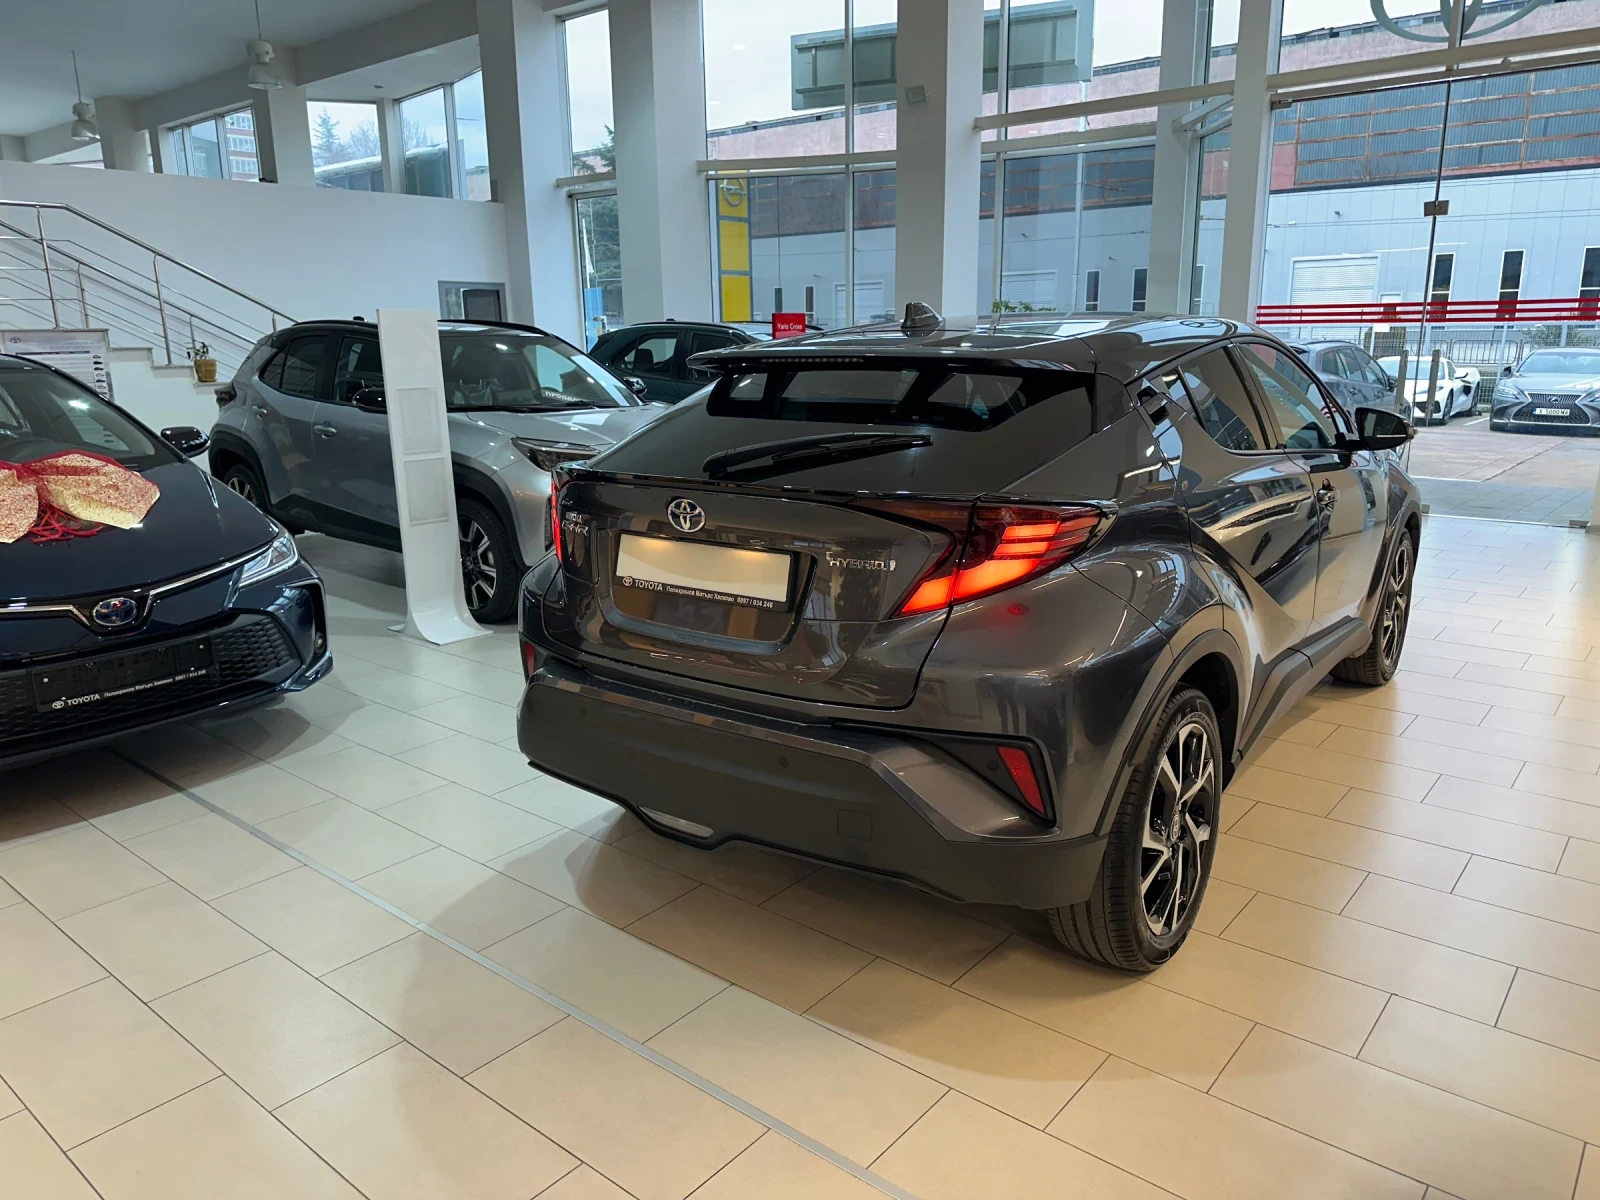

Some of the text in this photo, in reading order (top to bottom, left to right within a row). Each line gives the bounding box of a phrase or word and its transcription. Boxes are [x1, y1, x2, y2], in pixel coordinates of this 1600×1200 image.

[790, 322, 803, 330] Cross
[829, 557, 888, 571] HYBRID
[634, 579, 663, 592] TOYOTA
[714, 593, 735, 602] Хасково
[66, 693, 101, 706] TOYOTA
